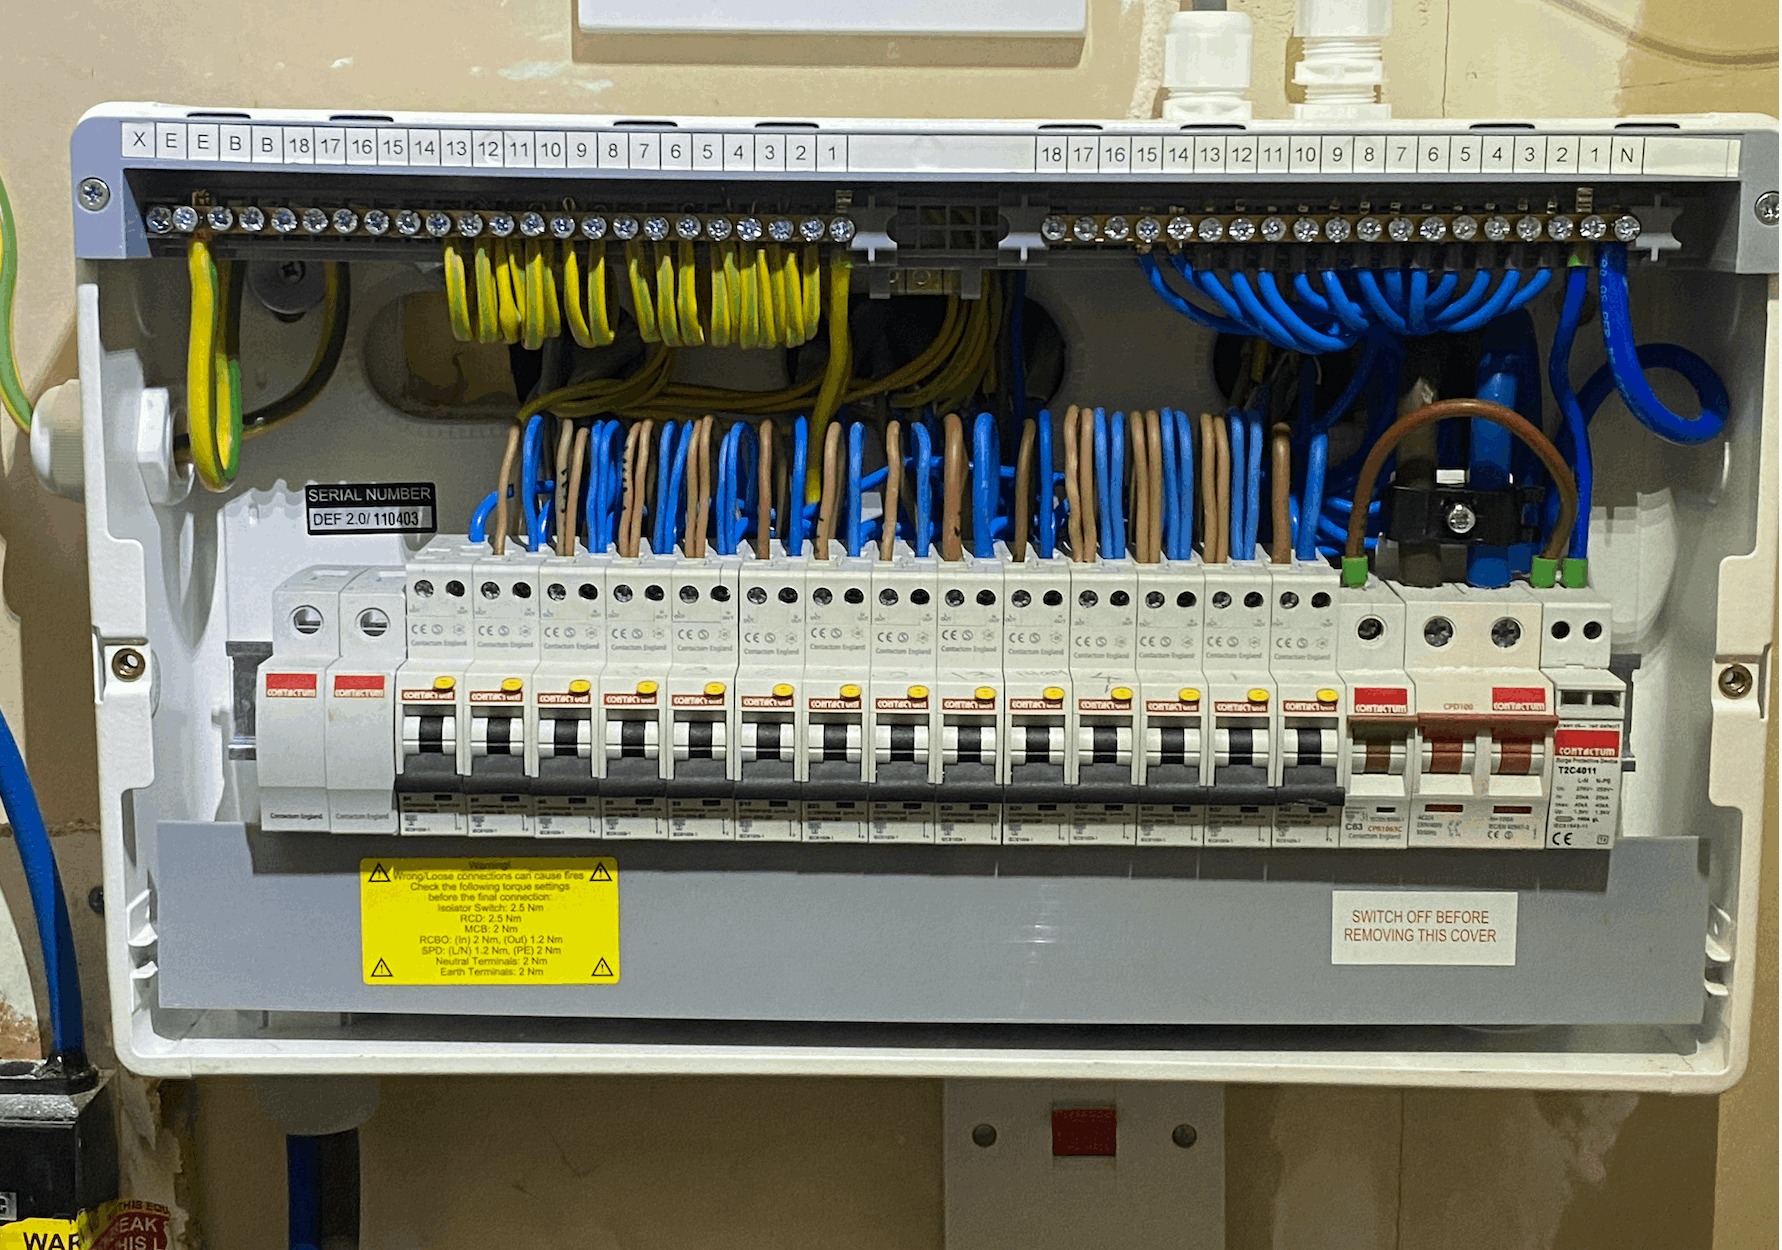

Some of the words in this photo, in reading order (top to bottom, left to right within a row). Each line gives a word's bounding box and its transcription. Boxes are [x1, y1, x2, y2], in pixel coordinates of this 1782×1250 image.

[133, 131, 146, 147] X
[165, 132, 177, 148] E
[196, 134, 209, 150] E
[229, 135, 242, 151] B
[261, 137, 273, 153] B
[289, 138, 310, 153] 18
[321, 138, 340, 153] 17
[352, 139, 373, 155] 16
[383, 139, 404, 155] 15
[415, 140, 435, 156] 14
[446, 141, 467, 156] 13
[478, 141, 499, 157] 12
[510, 141, 528, 157] 11
[541, 142, 561, 158] 10
[576, 142, 587, 158] 9
[608, 143, 618, 158] 8
[639, 143, 650, 159] 7
[670, 144, 681, 159] 6
[702, 144, 713, 160] 5
[732, 144, 744, 160] 4
[765, 144, 775, 160] 3
[796, 145, 806, 161] 2
[828, 146, 835, 161] 1
[1042, 147, 1062, 162] 18
[1074, 147, 1094, 162] 17
[1105, 147, 1126, 163] 16
[1137, 147, 1157, 163] 15
[1169, 147, 1189, 162] 14
[1200, 147, 1220, 163] 13
[1232, 147, 1252, 162] 12
[1264, 147, 1282, 162] 11
[1296, 147, 1316, 162] 10
[1332, 146, 1343, 163] 9
[1364, 146, 1374, 162] 8
[1396, 146, 1407, 162] 7
[1428, 146, 1439, 162] 6
[1460, 146, 1471, 162] 5
[1491, 146, 1503, 162] 4
[1525, 146, 1535, 162] 3
[1556, 147, 1568, 162] 2
[1590, 147, 1599, 163] 1
[1620, 147, 1633, 163] N
[309, 488, 362, 501] SERIAL
[366, 487, 431, 500] NUMBER
[313, 513, 342, 526] DEF
[346, 512, 370, 525] 2.0/
[374, 511, 419, 526] 110403
[1559, 747, 1615, 756] CONTACTUM
[1558, 766, 1596, 774] T2C4011
[394, 871, 454, 882] Wrong/Loose
[457, 872, 512, 880] connections
[564, 871, 584, 880] fires
[411, 882, 440, 890] Check
[442, 882, 456, 890] the
[460, 882, 500, 893] following
[502, 883, 532, 892] torque
[534, 883, 570, 892] settings
[428, 893, 458, 901] before
[460, 893, 476, 901] the
[478, 893, 497, 901] final
[500, 893, 552, 901] connection:
[438, 904, 471, 912] Isolator
[474, 903, 508, 912] Switch:
[510, 904, 525, 912] 2.5
[528, 904, 544, 912] Nm
[460, 914, 486, 922] RCD:
[488, 914, 503, 922] 2.5
[506, 914, 522, 922] Nm
[1352, 910, 1403, 924] SWITCH
[1406, 910, 1432, 924] OFF
[1436, 910, 1489, 924] BEFORE
[464, 925, 490, 933] MCB:
[494, 925, 499, 933] 2
[502, 925, 518, 933] Nm
[1344, 928, 1414, 942] REMOVING
[1419, 928, 1447, 942] THIS
[1450, 928, 1496, 943] COVER
[420, 936, 452, 944] RCBO:
[455, 936, 470, 945] (In)
[474, 936, 479, 944] 2
[482, 936, 500, 945] Nm,
[504, 936, 528, 945] (Out)
[531, 936, 544, 944] 1.2
[547, 936, 563, 944] Nm
[422, 946, 446, 955] SPD:
[448, 946, 472, 956] (L/N)
[475, 947, 488, 955] 1.2
[492, 947, 510, 956] Nm,
[514, 946, 534, 956] (PE)
[537, 947, 542, 955] 2
[546, 946, 562, 955] Nm
[436, 957, 469, 966] Neutral
[472, 957, 520, 966] Terminals:
[523, 958, 528, 966] 2
[532, 957, 548, 966] Nm
[440, 968, 465, 976] Earth
[468, 968, 516, 976] Terminals:
[519, 968, 524, 976] 2
[528, 968, 544, 976] Nm
